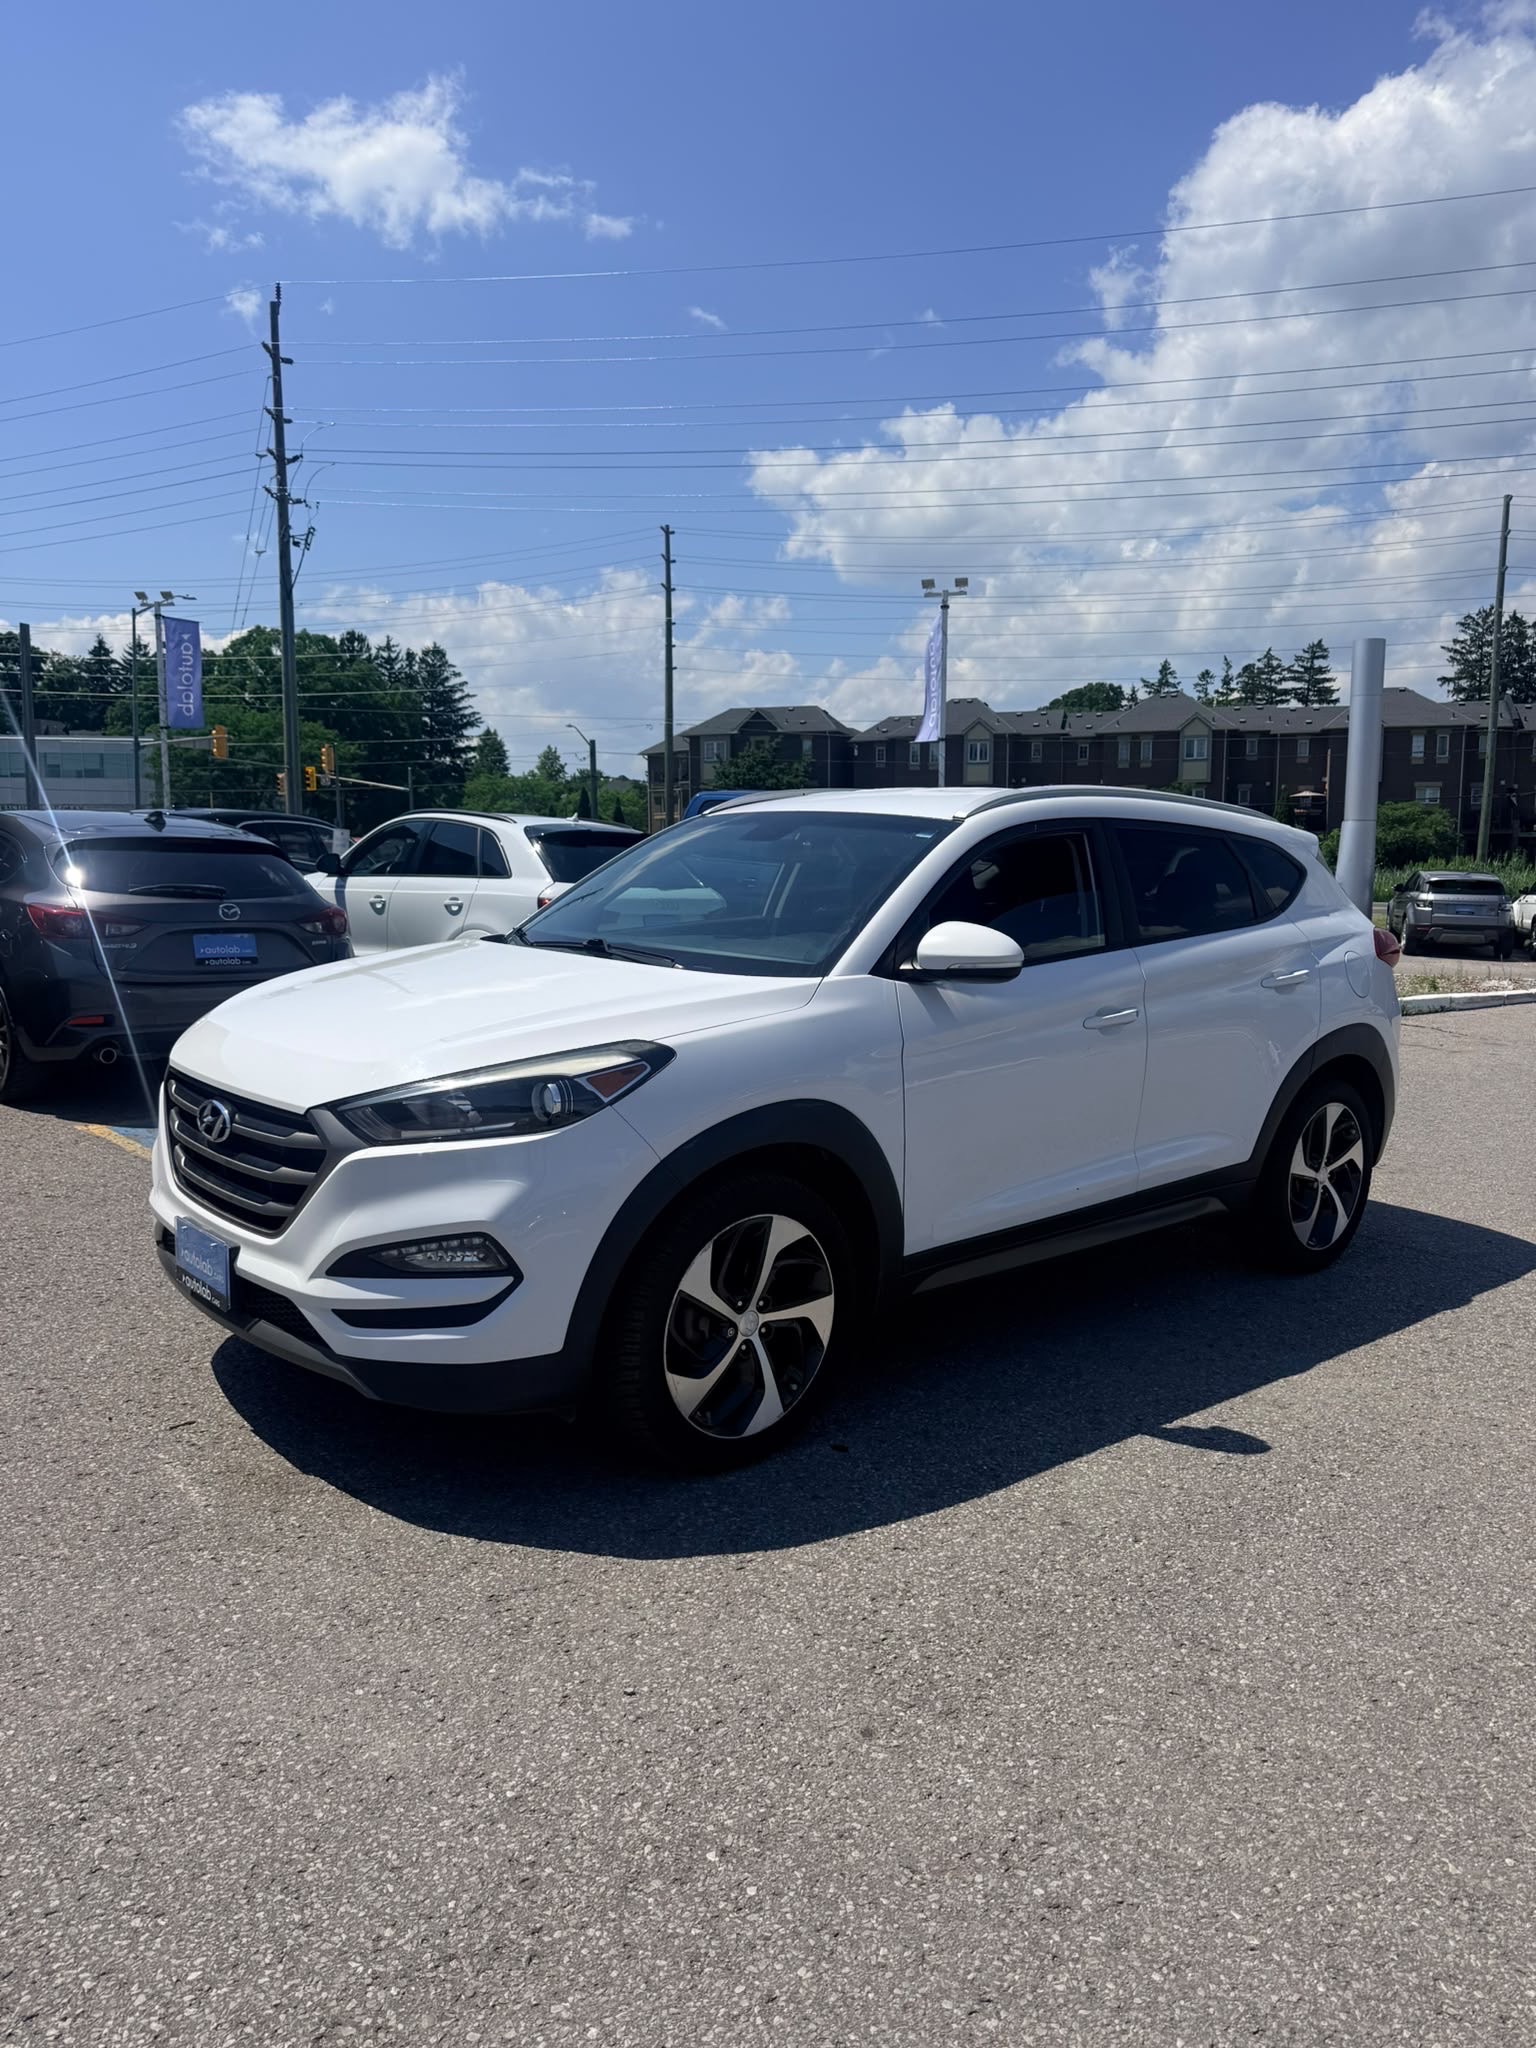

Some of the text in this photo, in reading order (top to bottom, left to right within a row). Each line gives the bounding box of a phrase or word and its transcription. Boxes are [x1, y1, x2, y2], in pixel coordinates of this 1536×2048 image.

[205, 945, 240, 954] autolab
[210, 957, 241, 965] autolab
[184, 1250, 213, 1276] autolab
[185, 1276, 212, 1301] autolab
